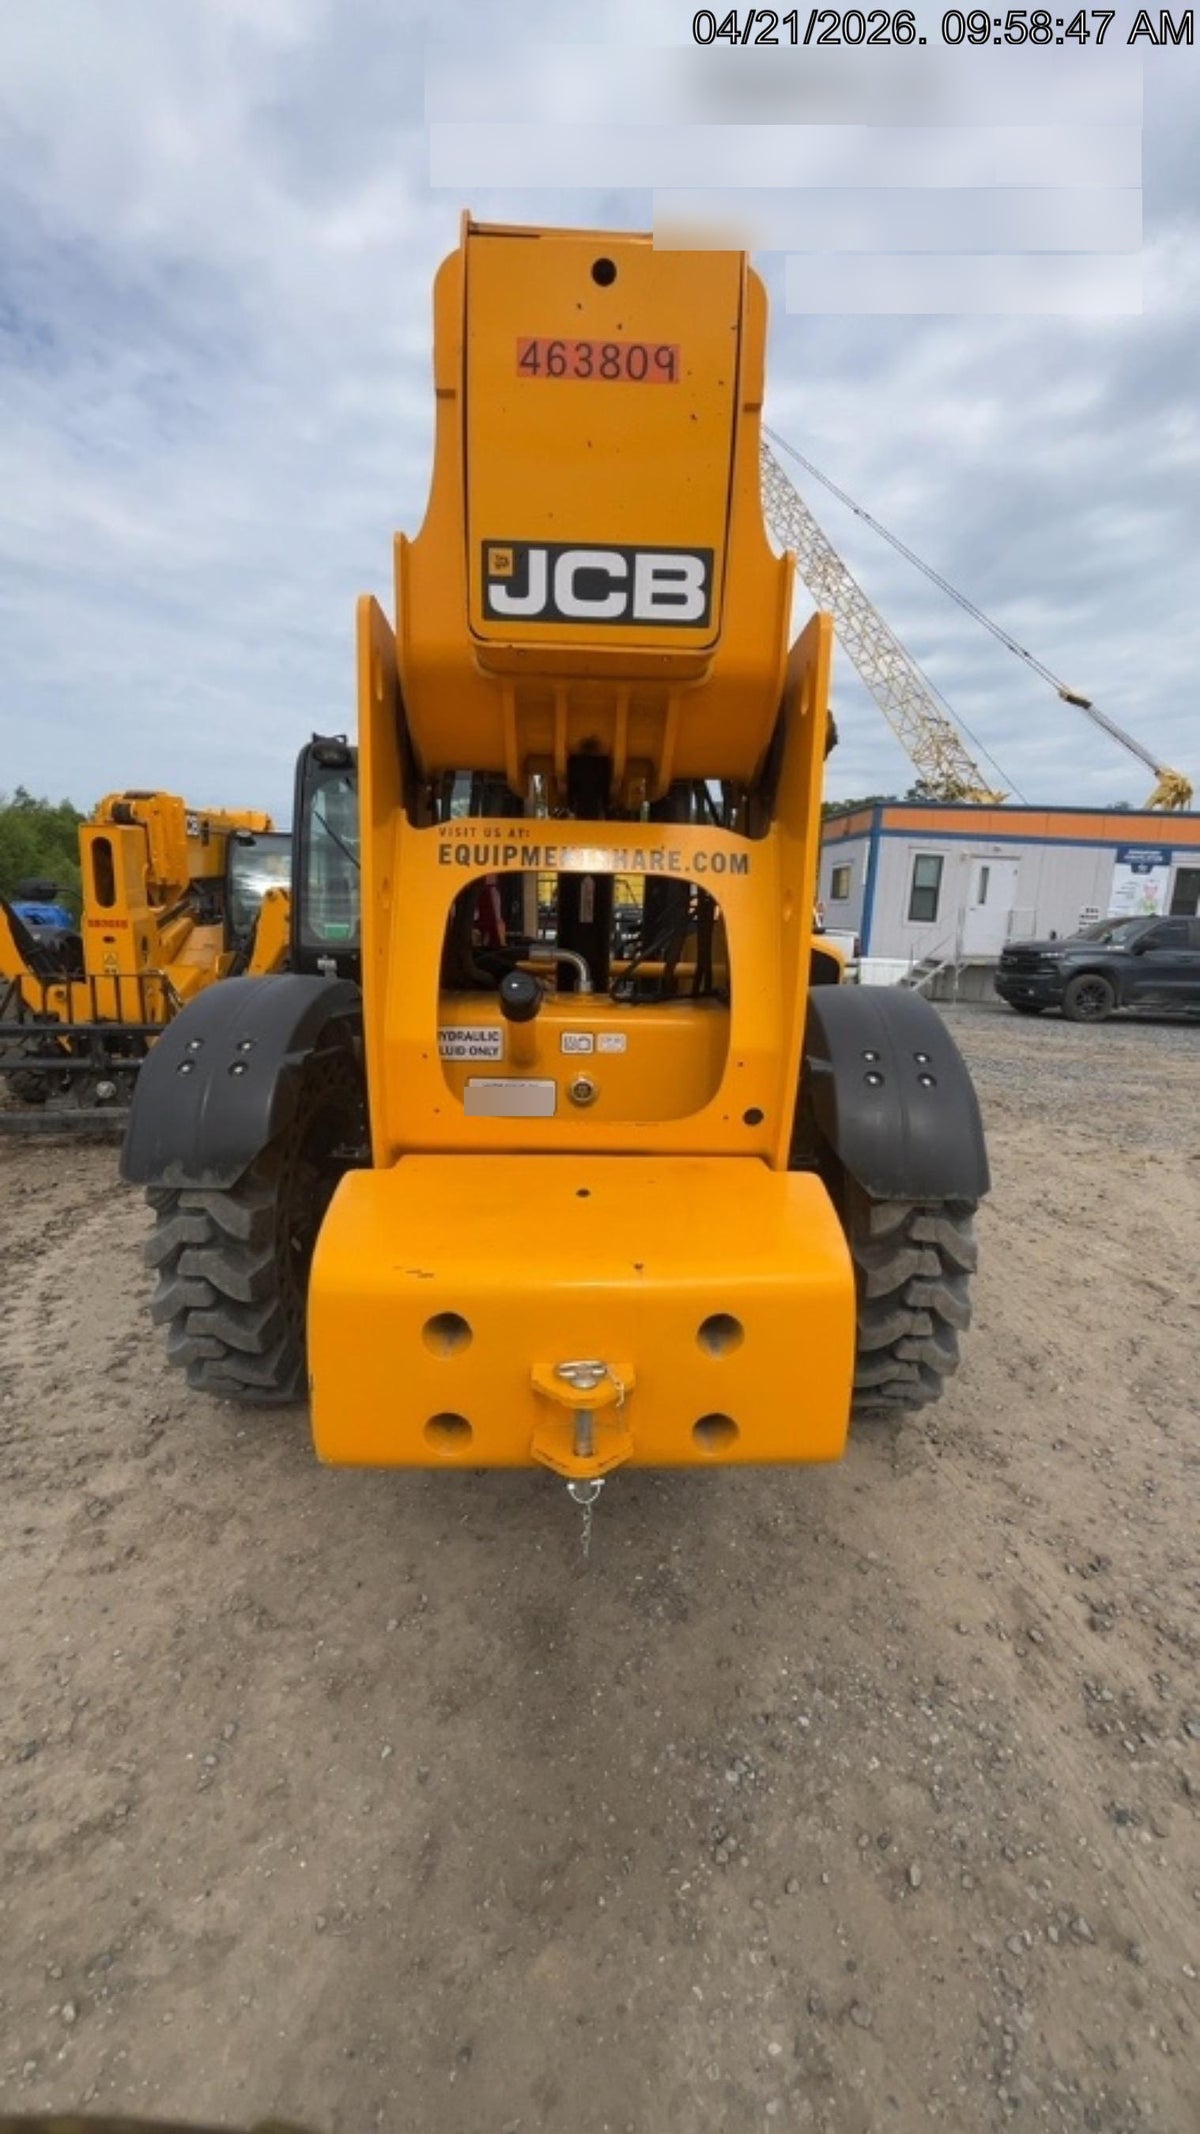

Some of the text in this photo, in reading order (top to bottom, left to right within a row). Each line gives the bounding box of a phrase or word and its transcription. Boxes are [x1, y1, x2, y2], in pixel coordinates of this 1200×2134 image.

[519, 340, 675, 382] 463809
[488, 549, 706, 620] JCB
[438, 826, 530, 838] VISIT US AT:
[438, 843, 749, 875] EQUIPMEHARE.COM
[438, 1044, 498, 1056] LUID ONLY
